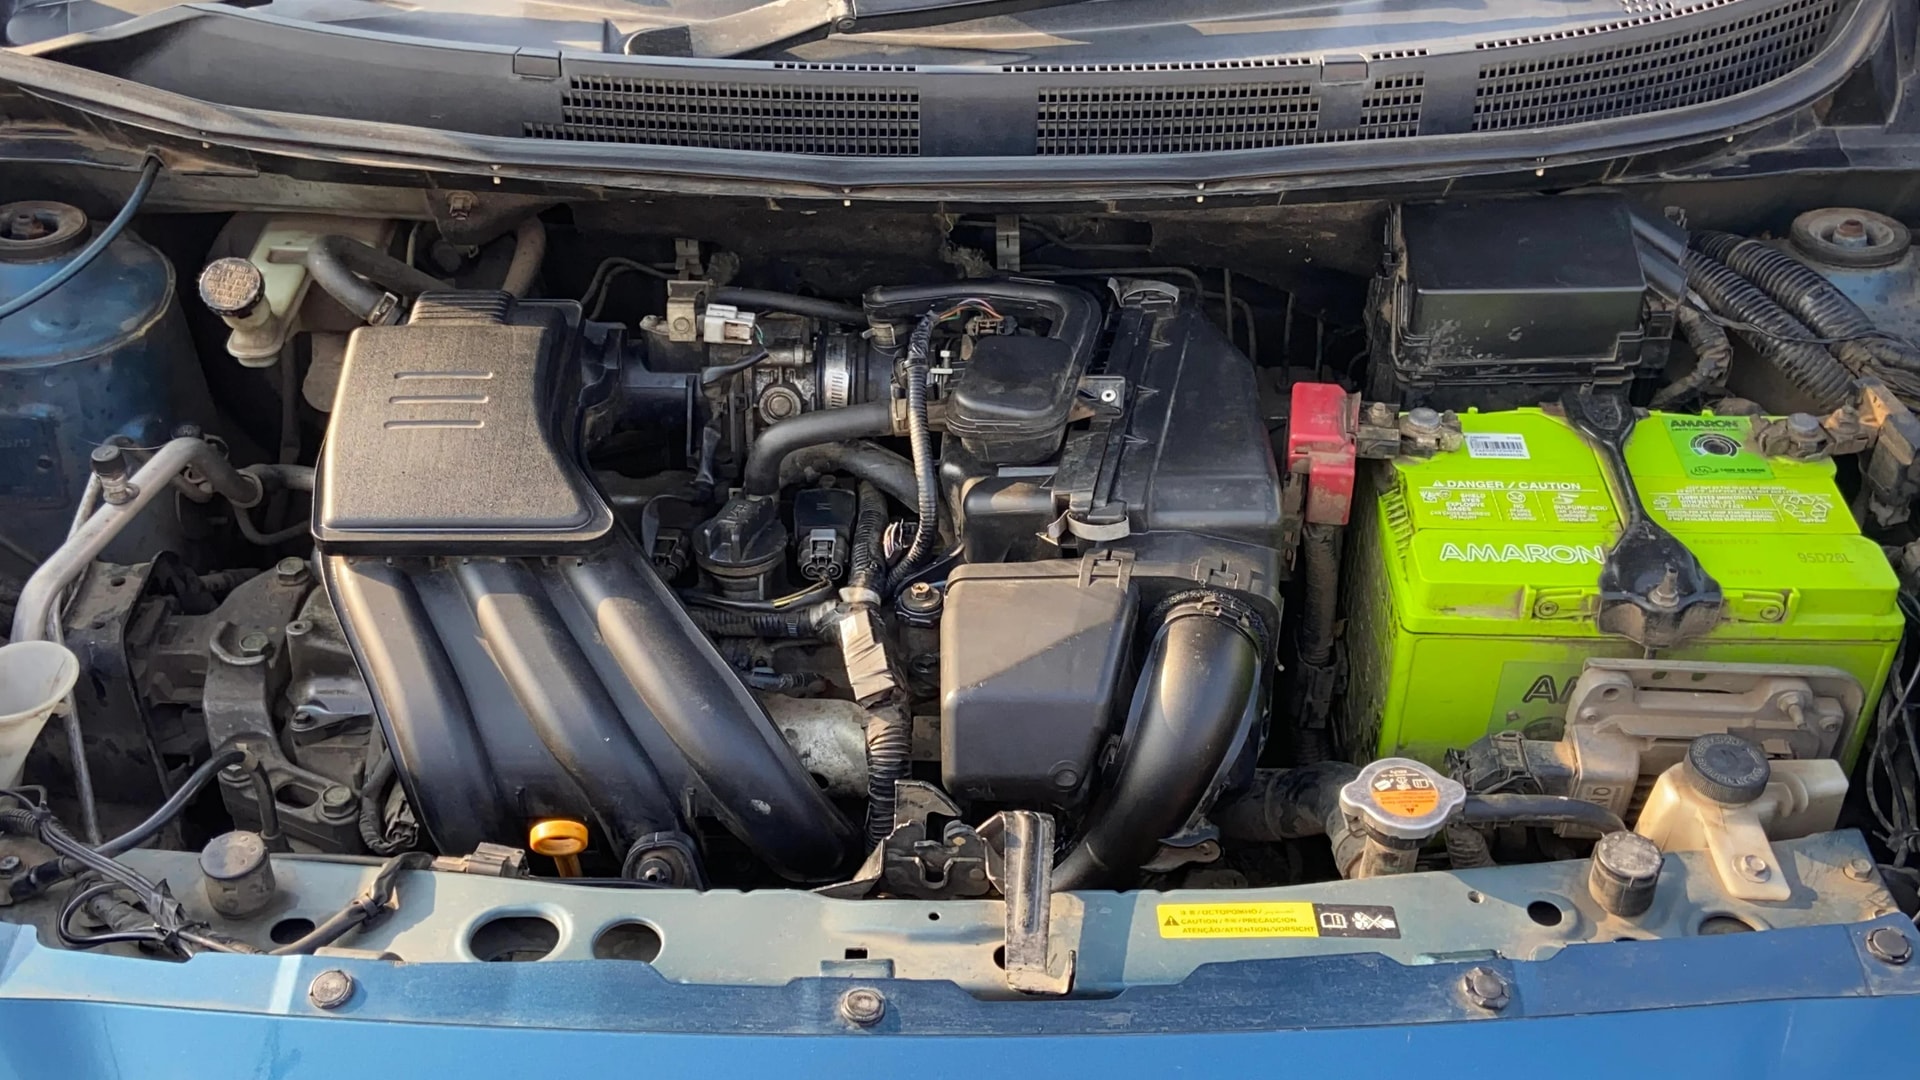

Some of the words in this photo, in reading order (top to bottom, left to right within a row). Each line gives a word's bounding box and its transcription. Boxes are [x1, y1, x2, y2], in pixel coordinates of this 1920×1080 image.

[1671, 420, 1738, 428] AMARON
[1447, 480, 1504, 489] DANGER
[1518, 482, 1580, 490] CAUTION
[1439, 542, 1606, 565] AMARON
